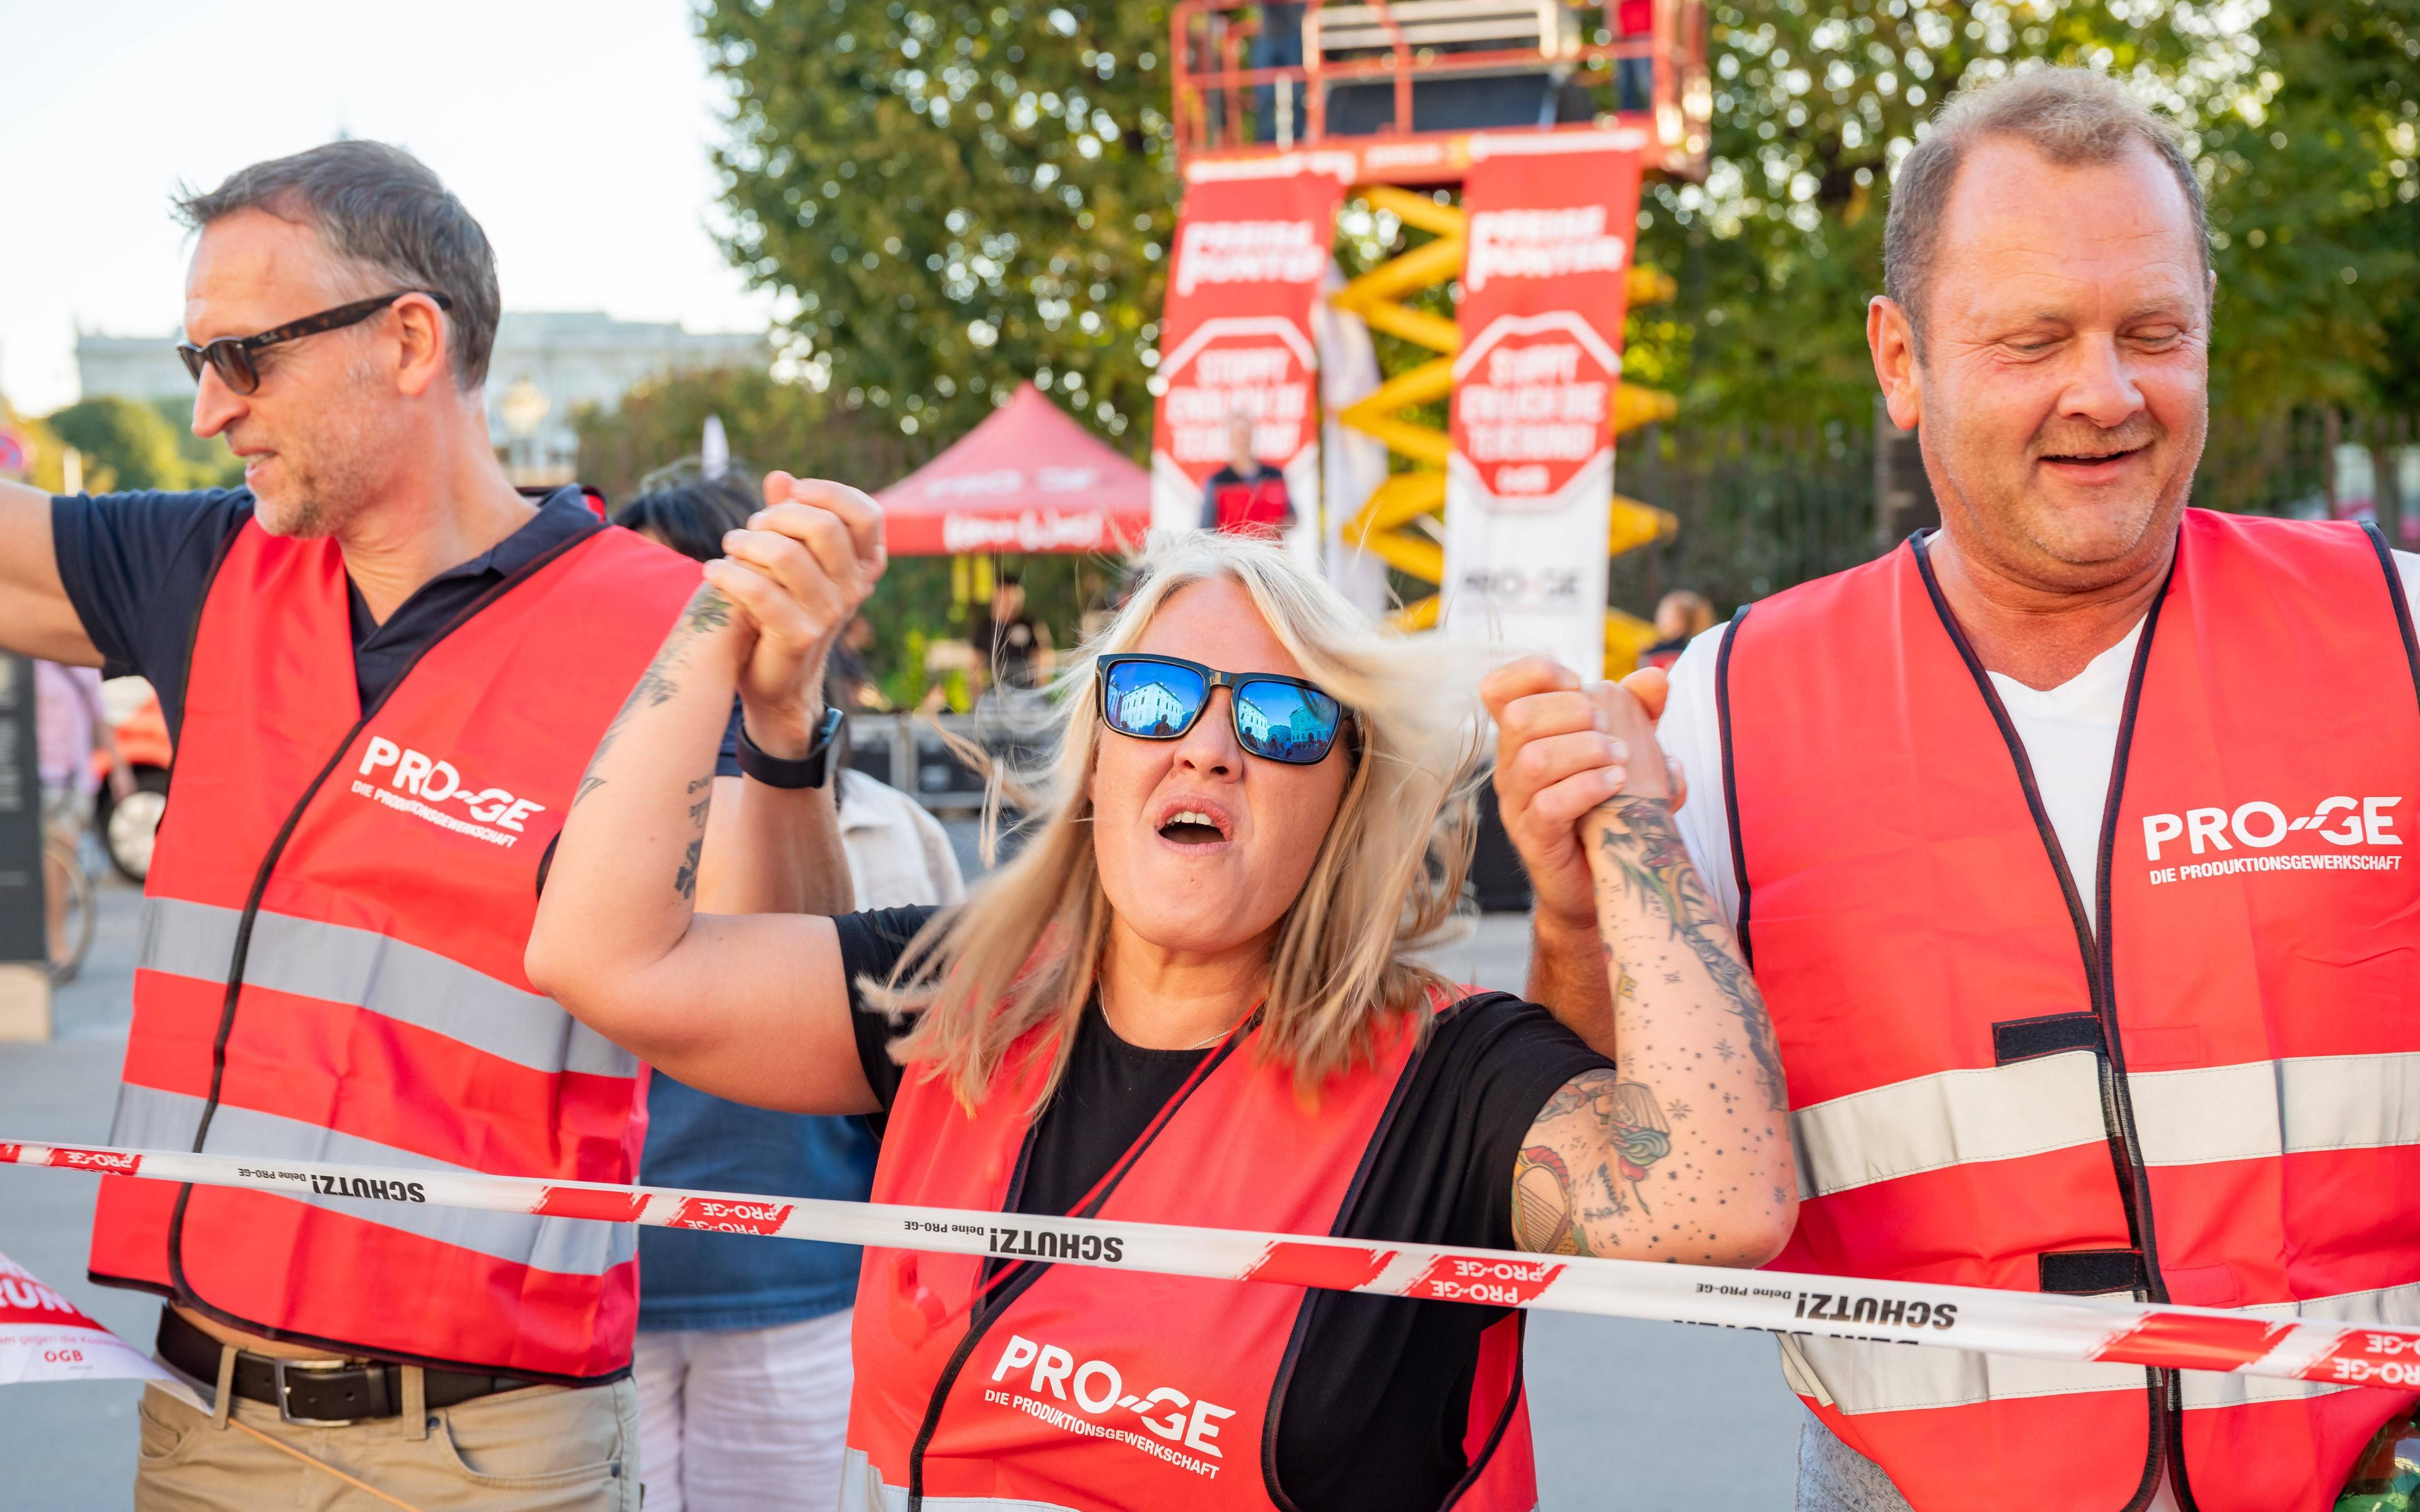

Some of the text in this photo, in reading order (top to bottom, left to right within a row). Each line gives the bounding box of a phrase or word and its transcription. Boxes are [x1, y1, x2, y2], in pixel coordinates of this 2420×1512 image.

[351, 779, 375, 798] DIE
[358, 735, 546, 832] PRO-GE
[2142, 796, 2404, 861] PRO-GE
[2150, 855, 2402, 885] DIE PRODUKTIONSGEWERKSCHAFT
[238, 1168, 426, 1203] SCHUTZ! Deine PRO-GE
[699, 1201, 777, 1222] PRO-GE
[904, 1220, 1124, 1262] SCHUTZ! Deine PRO-GE
[1453, 1260, 1543, 1283] PRO-GE
[1430, 1280, 1518, 1305] PRO-GE
[1696, 1283, 1748, 1297] PRO-GE
[1753, 1288, 1792, 1300] Deine
[1794, 1292, 1959, 1331] SCHUTZ!
[991, 1334, 1236, 1458] PRO-GE
[984, 1389, 1220, 1480] DIE PRODUKTIONSGEWERKSCHAFT
